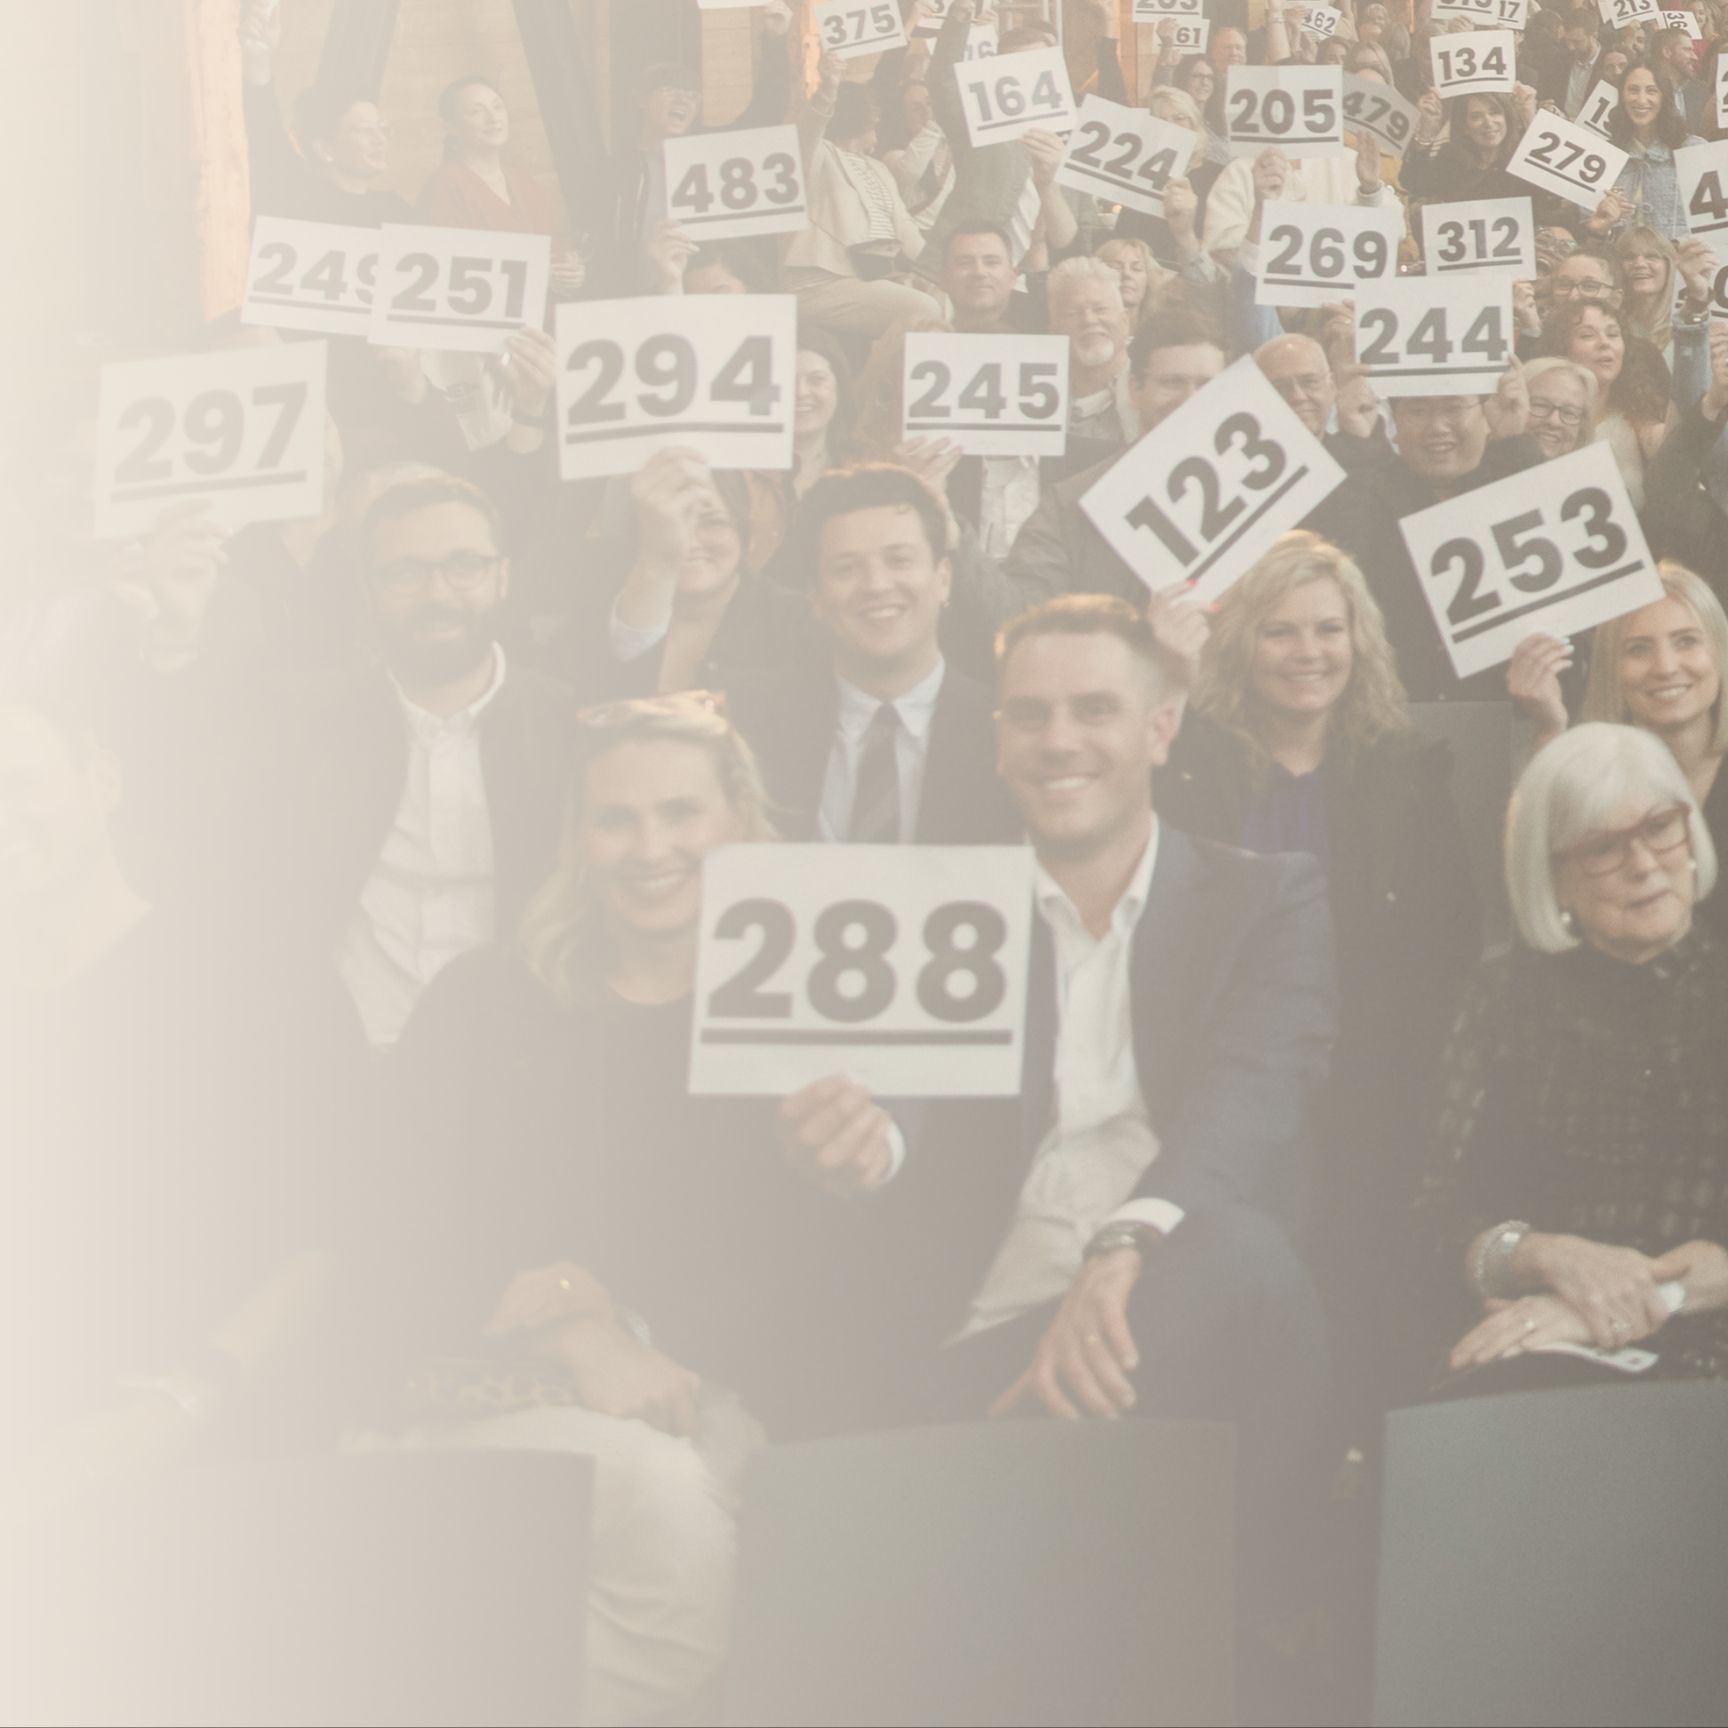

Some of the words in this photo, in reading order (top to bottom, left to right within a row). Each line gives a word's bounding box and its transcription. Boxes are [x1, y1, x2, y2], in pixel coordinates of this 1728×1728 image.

[824, 4, 897, 45] 375
[1176, 27, 1200, 45] 61
[1500, 0, 1520, 18] 17
[1666, 12, 1688, 30] 36
[1438, 46, 1507, 79] 134
[968, 70, 1062, 123] 164
[1228, 88, 1336, 134] 205
[1343, 90, 1410, 141] 479
[671, 152, 800, 213] 483
[1070, 120, 1178, 190] 224
[1529, 132, 1606, 183] 279
[1267, 224, 1388, 279] 269
[1438, 216, 1522, 262] 312
[391, 252, 528, 318] 251
[1358, 306, 1508, 365] 244
[565, 332, 781, 426] 294
[909, 360, 1060, 420] 245
[114, 381, 308, 485] 297
[1124, 411, 1287, 568] 123
[1430, 486, 1628, 627] 253
[707, 898, 1009, 1024] 288
